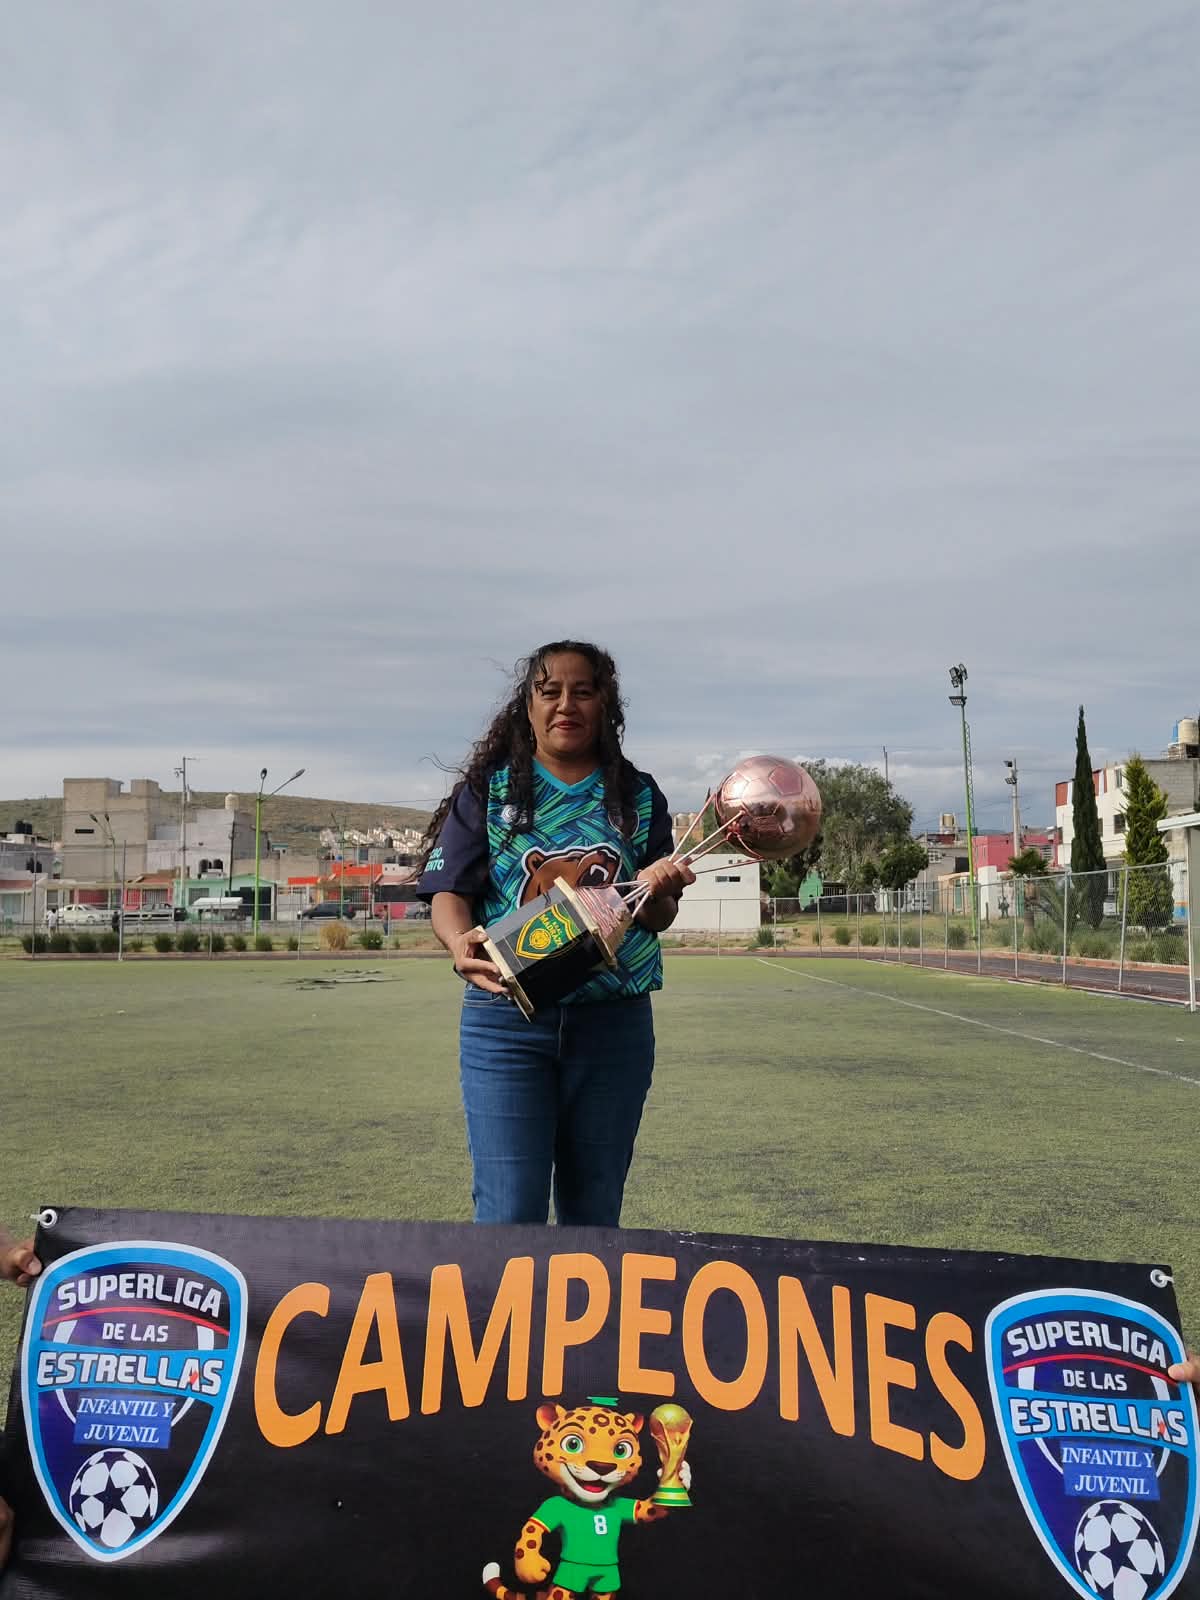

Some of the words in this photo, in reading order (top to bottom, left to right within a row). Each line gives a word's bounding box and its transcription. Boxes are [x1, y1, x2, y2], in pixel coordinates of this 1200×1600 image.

[57, 1273, 222, 1318] SUPERLIGA
[102, 1322, 126, 1341] DE
[130, 1323, 169, 1343] LAS
[1007, 1320, 1167, 1368] SUPERLIGA
[37, 1351, 224, 1396] ESTRELLAS
[254, 1252, 986, 1481] CAMPEONES
[1062, 1369, 1087, 1388] DE
[1091, 1371, 1128, 1391] LAS
[76, 1398, 159, 1418] INFANTIL
[161, 1401, 176, 1418] Y
[1009, 1398, 1189, 1446] ESTRELLAS
[83, 1423, 160, 1444] JUVENIL
[1061, 1447, 1142, 1467] INFANTIL
[1143, 1452, 1155, 1468] Y
[1074, 1475, 1150, 1495] JUVENIL
[593, 1514, 608, 1535] 8
